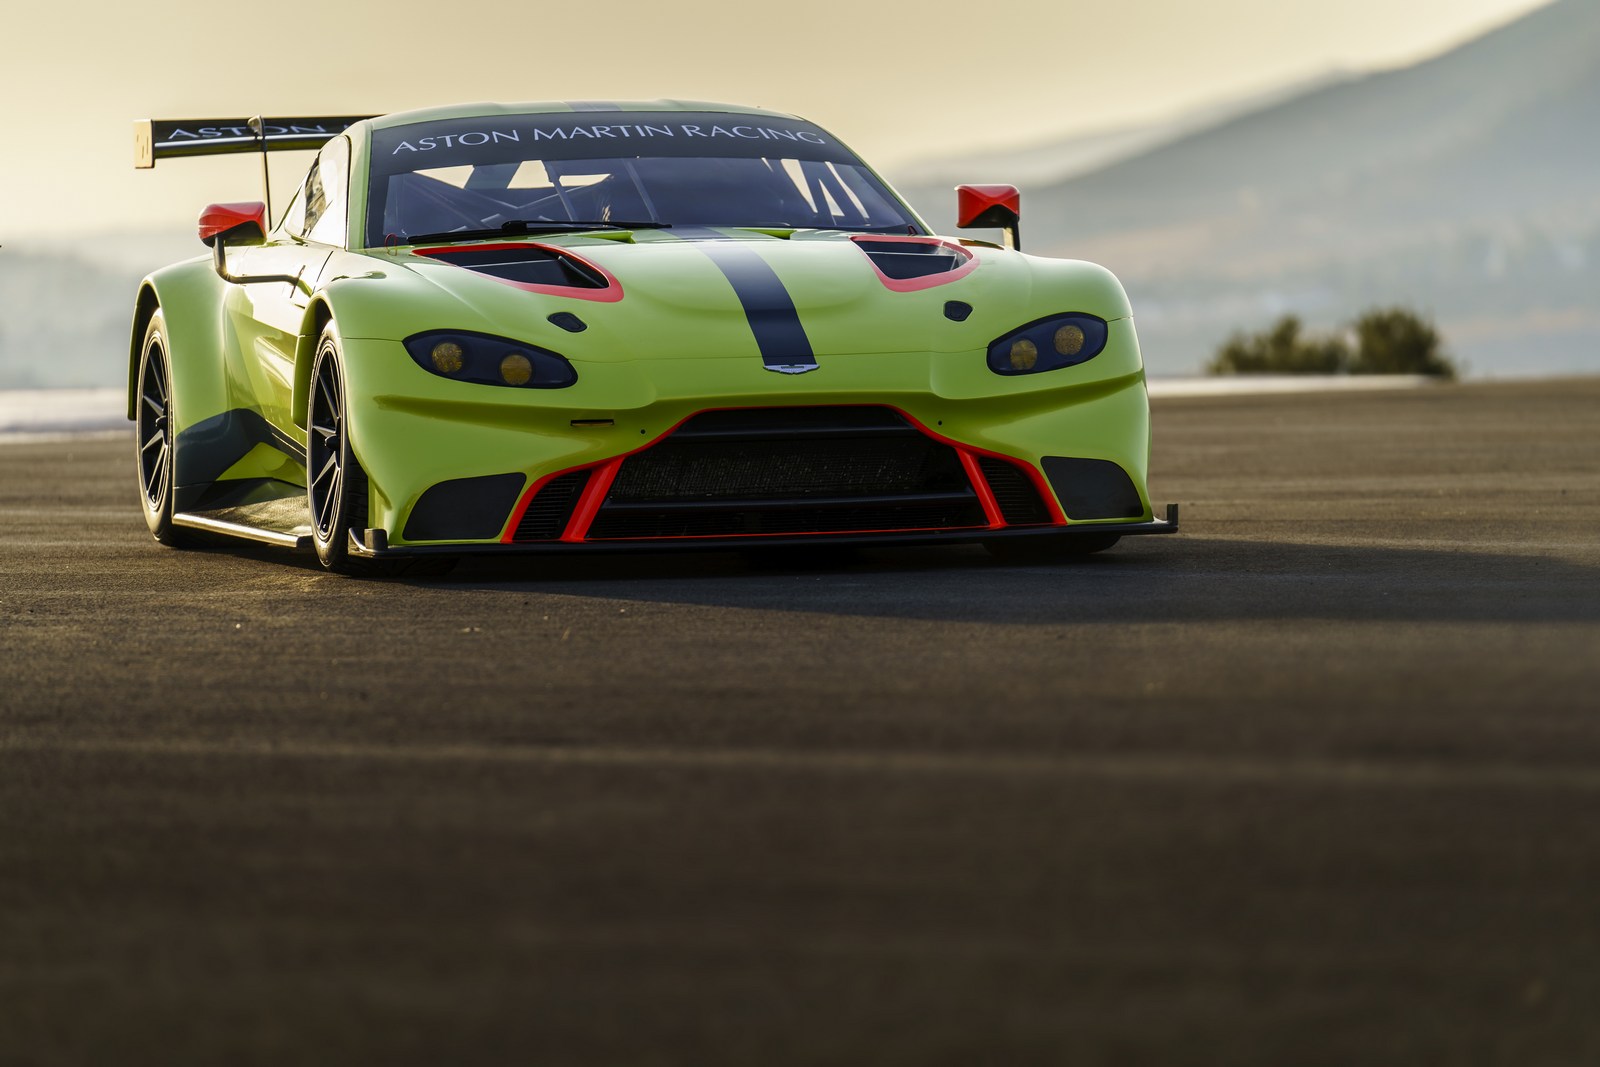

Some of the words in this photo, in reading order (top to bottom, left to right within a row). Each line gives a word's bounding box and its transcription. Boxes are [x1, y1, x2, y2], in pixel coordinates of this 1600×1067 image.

[392, 129, 520, 155] ASTON
[534, 125, 674, 141] MARTIN
[681, 125, 826, 145] RACING
